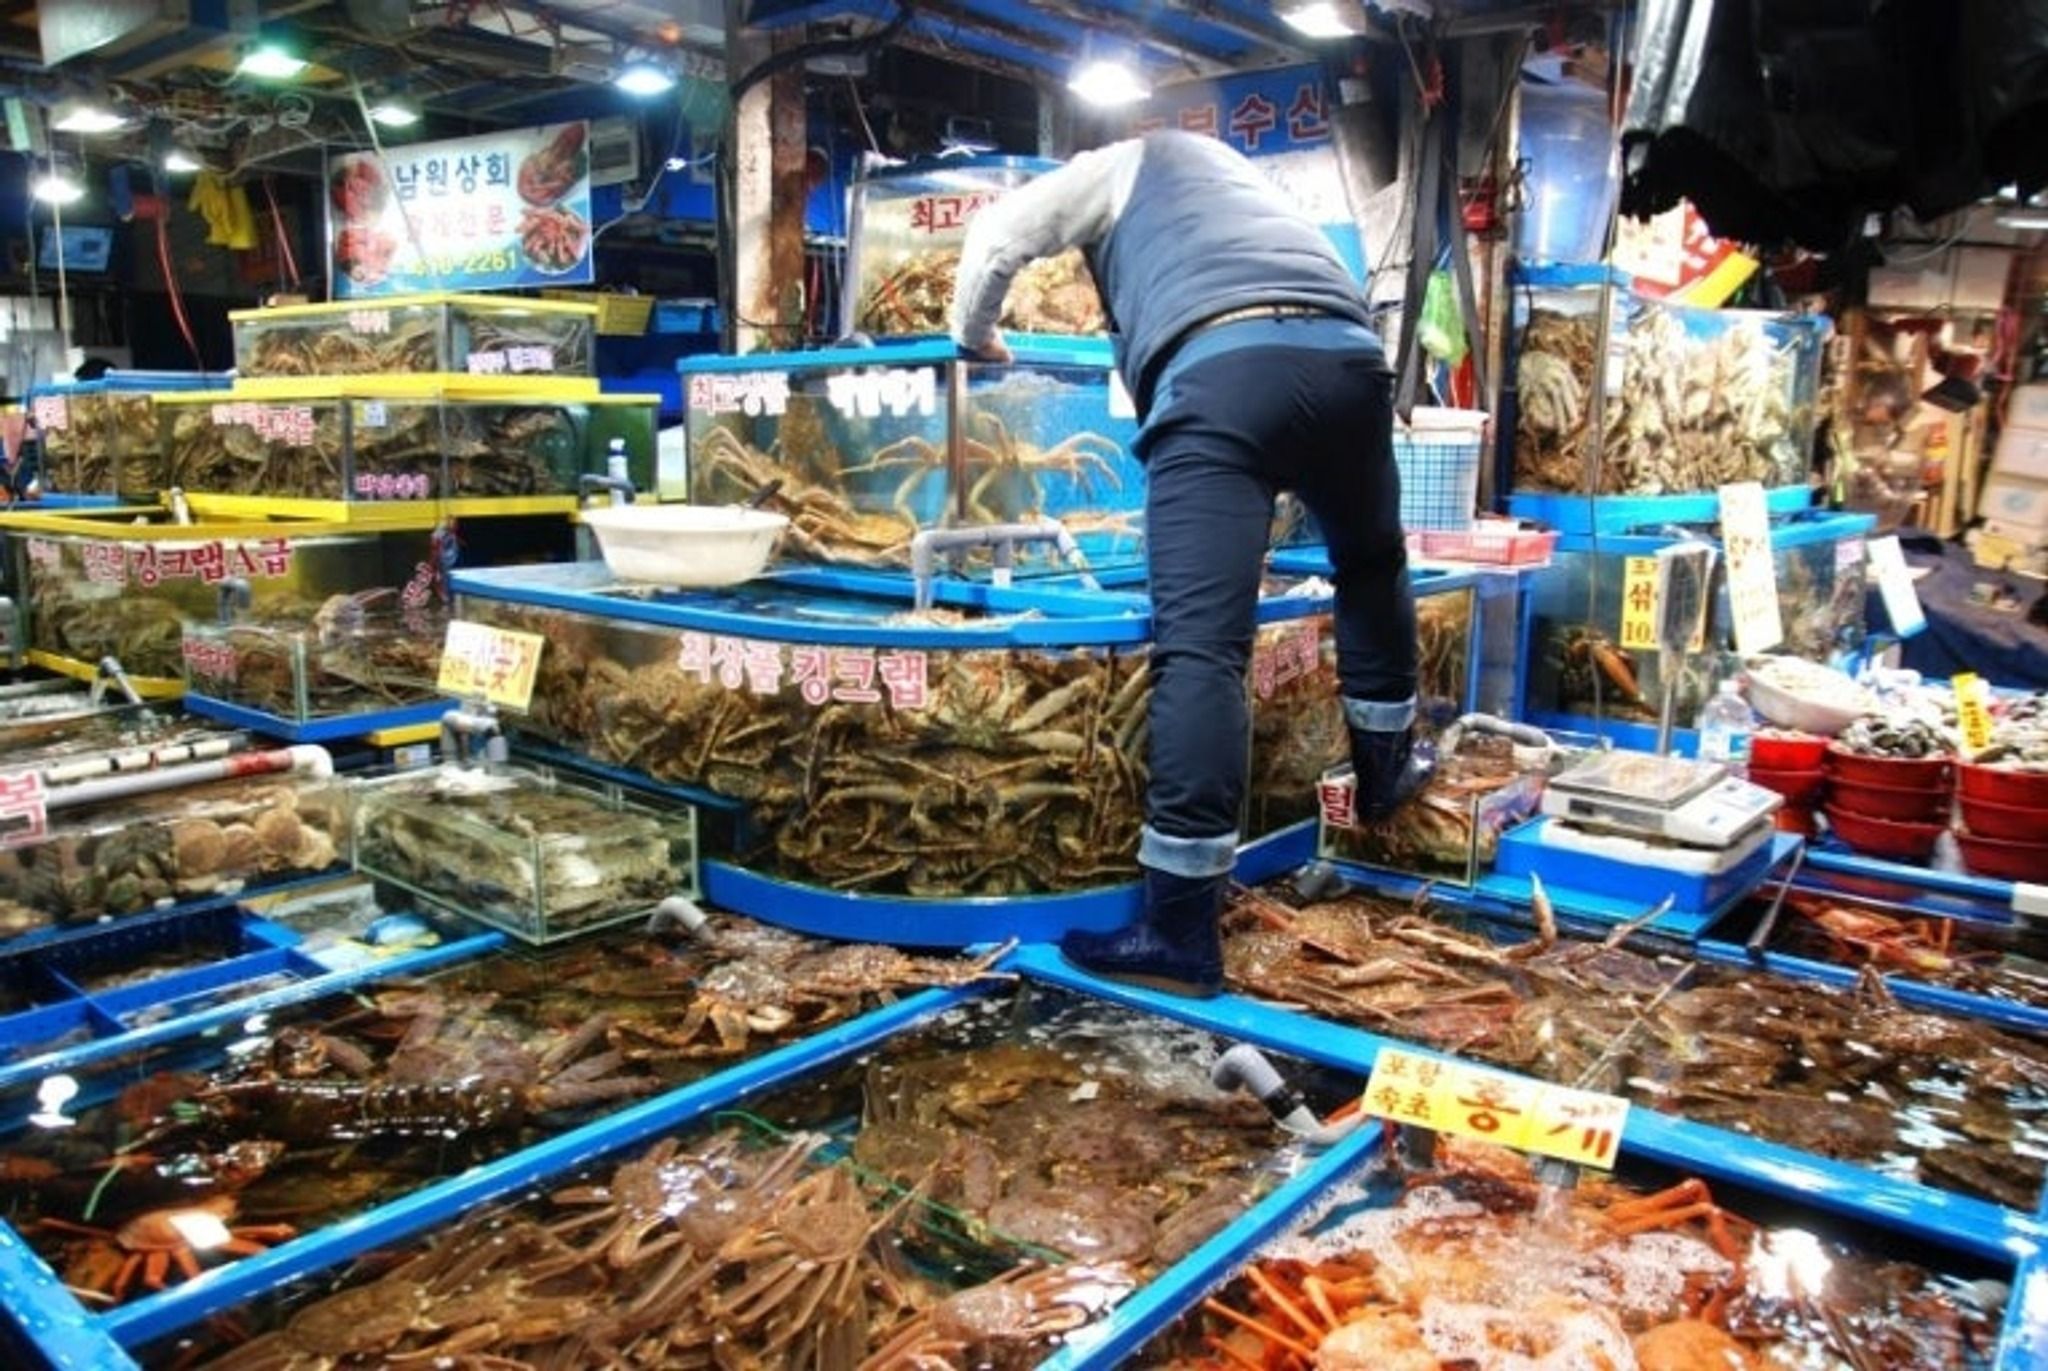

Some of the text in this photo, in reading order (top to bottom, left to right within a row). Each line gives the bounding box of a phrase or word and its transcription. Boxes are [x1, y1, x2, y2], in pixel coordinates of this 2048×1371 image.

[396, 152, 511, 200] 남원상회
[132, 542, 228, 587] 킹크랩
[678, 631, 928, 710] 최상품 킹크랩
[1373, 1085, 1433, 1121] 속초
